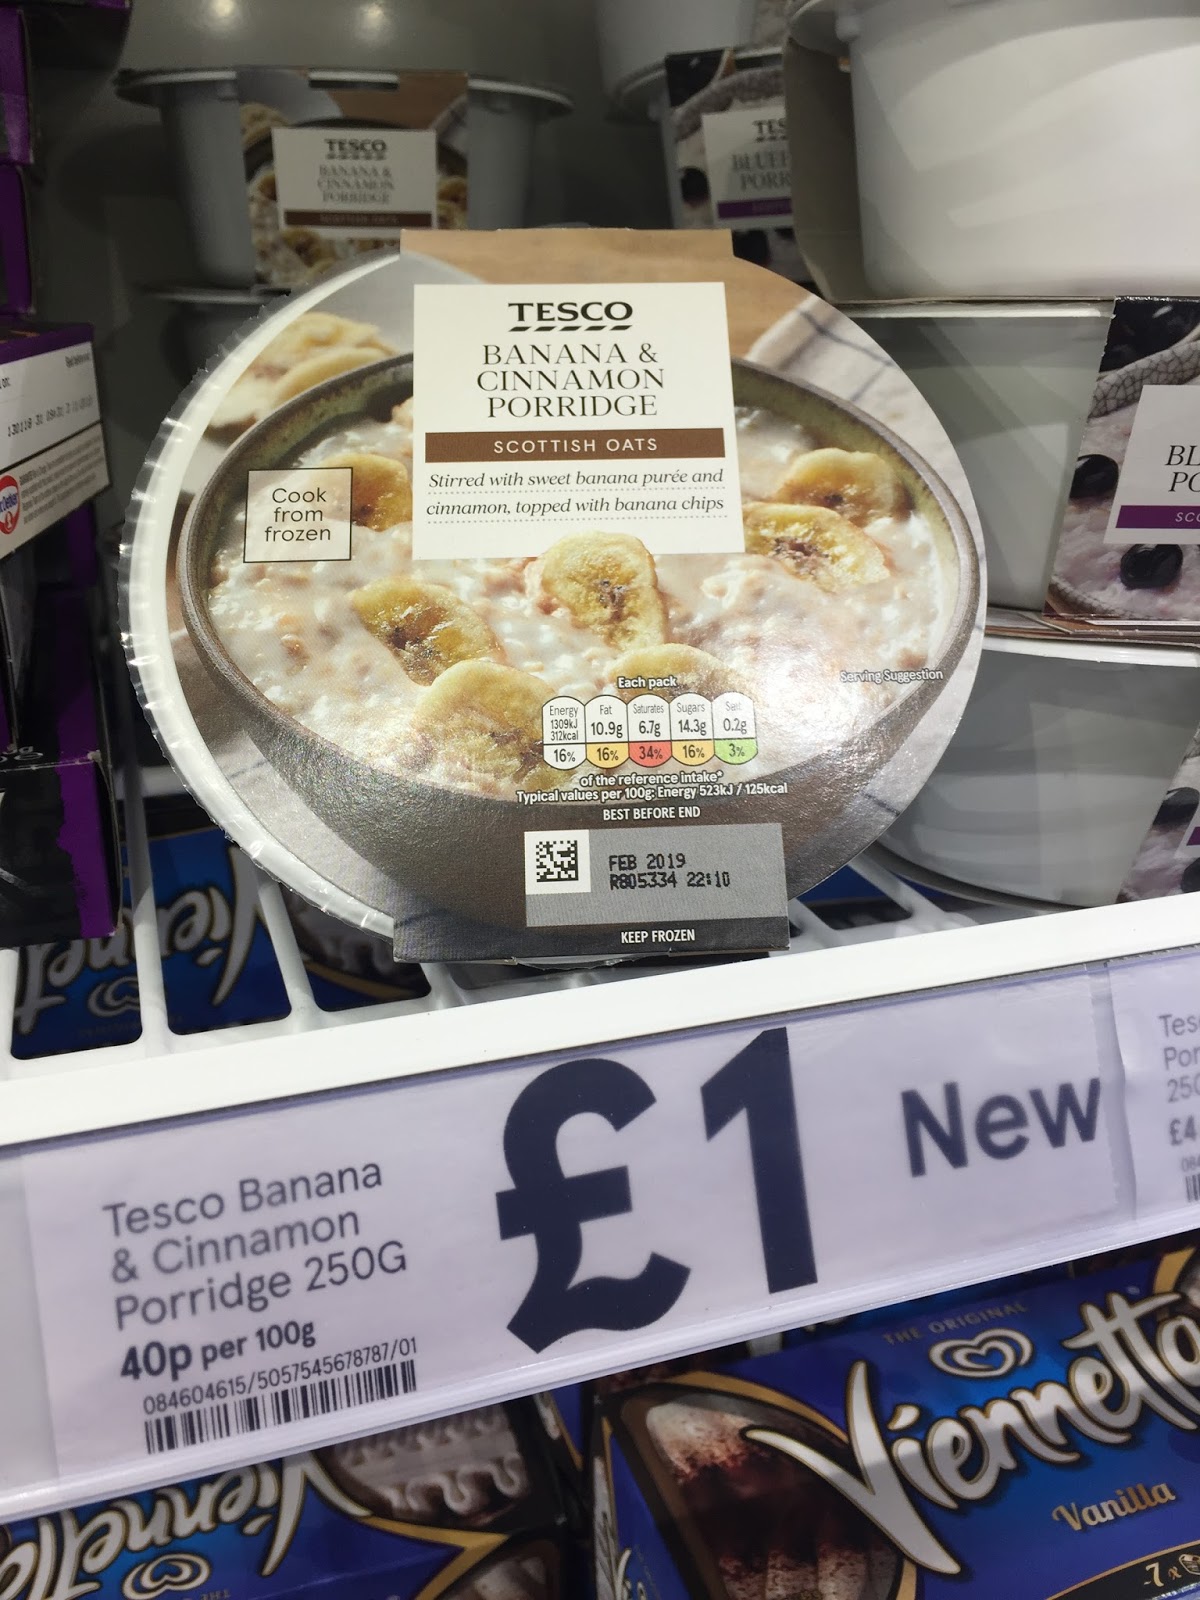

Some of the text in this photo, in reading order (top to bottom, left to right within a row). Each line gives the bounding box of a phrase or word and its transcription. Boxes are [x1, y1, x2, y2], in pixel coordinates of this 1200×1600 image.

[325, 138, 387, 151] TESCO
[508, 301, 633, 321] TESCO
[483, 343, 658, 365] BANANA &
[477, 368, 664, 391] CINNAMON
[488, 395, 658, 418] PORRIDGE
[493, 438, 658, 454] SCOTTISH OATS
[429, 468, 724, 488] Stirred with sweet banana purée and
[272, 487, 327, 503] Cook
[426, 496, 724, 516] cinnamon, topped with banana chips
[274, 507, 323, 522] from
[1175, 511, 1200, 522] SC
[264, 526, 331, 542] frozen
[617, 675, 677, 690] Each pack
[840, 668, 944, 684] Serving Suggestion
[549, 705, 579, 718] Energy
[599, 705, 613, 715] Fat
[633, 704, 665, 714] Saturates
[676, 702, 706, 715] Sugars
[550, 719, 578, 730] 1309kJ
[591, 721, 623, 738] 10.9g
[638, 720, 661, 737] 6.7g
[678, 719, 707, 736] 14.3g
[723, 718, 747, 734] 0.2g
[550, 730, 579, 741] 312kcal
[553, 748, 576, 763] 16%
[597, 747, 619, 761] 16%
[638, 745, 663, 760] 34%
[682, 744, 705, 758] 16%
[728, 743, 746, 757] 3%
[580, 774, 593, 786] of
[595, 774, 616, 786] the
[618, 772, 679, 785] reference
[516, 782, 788, 805] Typical values per 100g: Energy 523kJ / 125kcal
[603, 806, 701, 820] BEST BEFORE END
[609, 853, 687, 871] FEB 2019
[610, 871, 730, 890] R805334 22:10
[621, 929, 695, 943] KEEP FROZEN
[1158, 1014, 1200, 1038] Tes
[901, 1077, 1101, 1178] New
[496, 1026, 818, 1354] £1
[102, 1162, 383, 1237] Tesco Banana
[111, 1211, 360, 1284] & Cinnamon
[114, 1240, 407, 1331] Porridge 250G
[883, 1302, 1028, 1346] THE ORIGINAL
[120, 1321, 317, 1382] 40p per 100g
[143, 1337, 418, 1415] 084604615/5057545678787/01
[743, 1290, 1200, 1575] Viennetta
[1052, 1483, 1176, 1531] Vanilla
